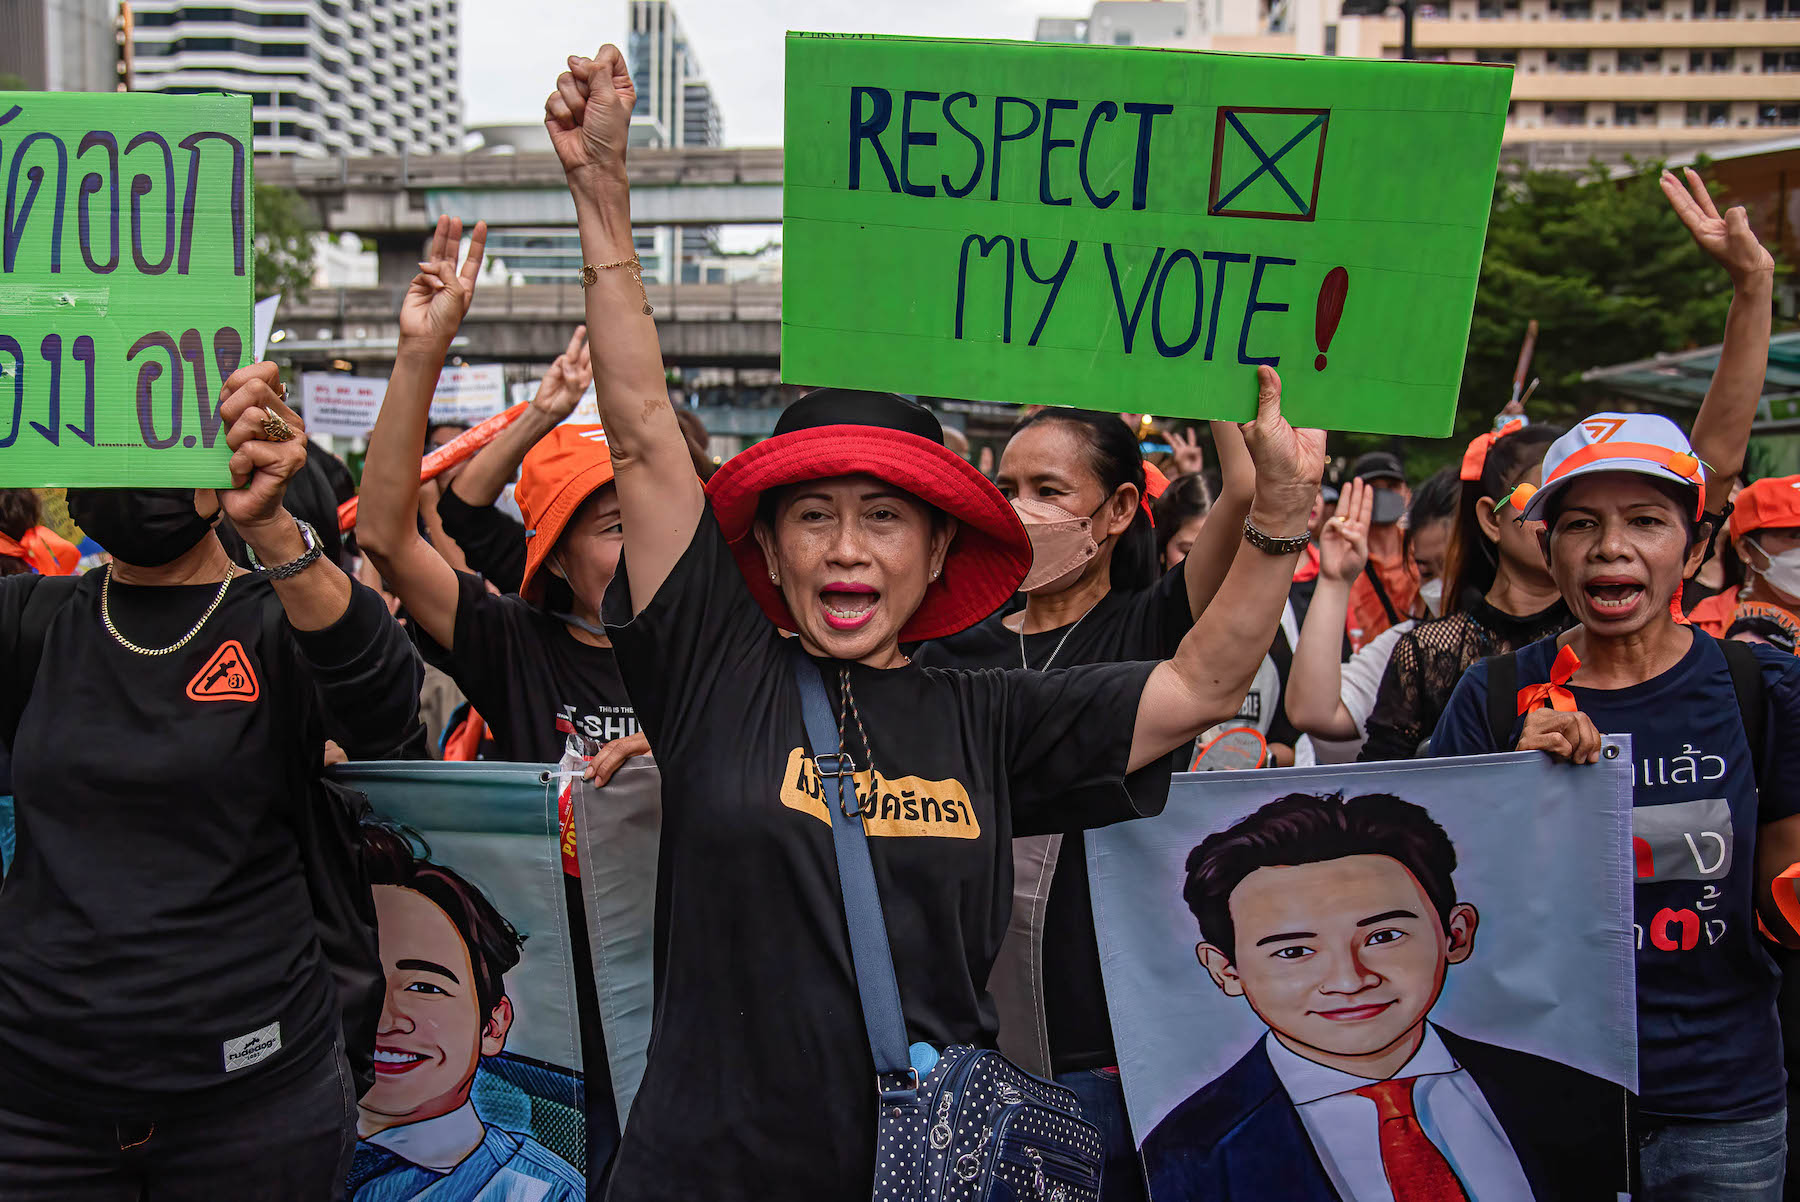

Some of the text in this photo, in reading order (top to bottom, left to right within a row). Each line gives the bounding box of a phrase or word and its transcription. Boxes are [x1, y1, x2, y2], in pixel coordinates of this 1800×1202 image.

[848, 86, 1174, 211] RESPECT
[954, 233, 1079, 347] MY
[562, 703, 643, 741] T-SHI
[620, 706, 634, 714] THE
[1632, 743, 1726, 787] แล้ว
